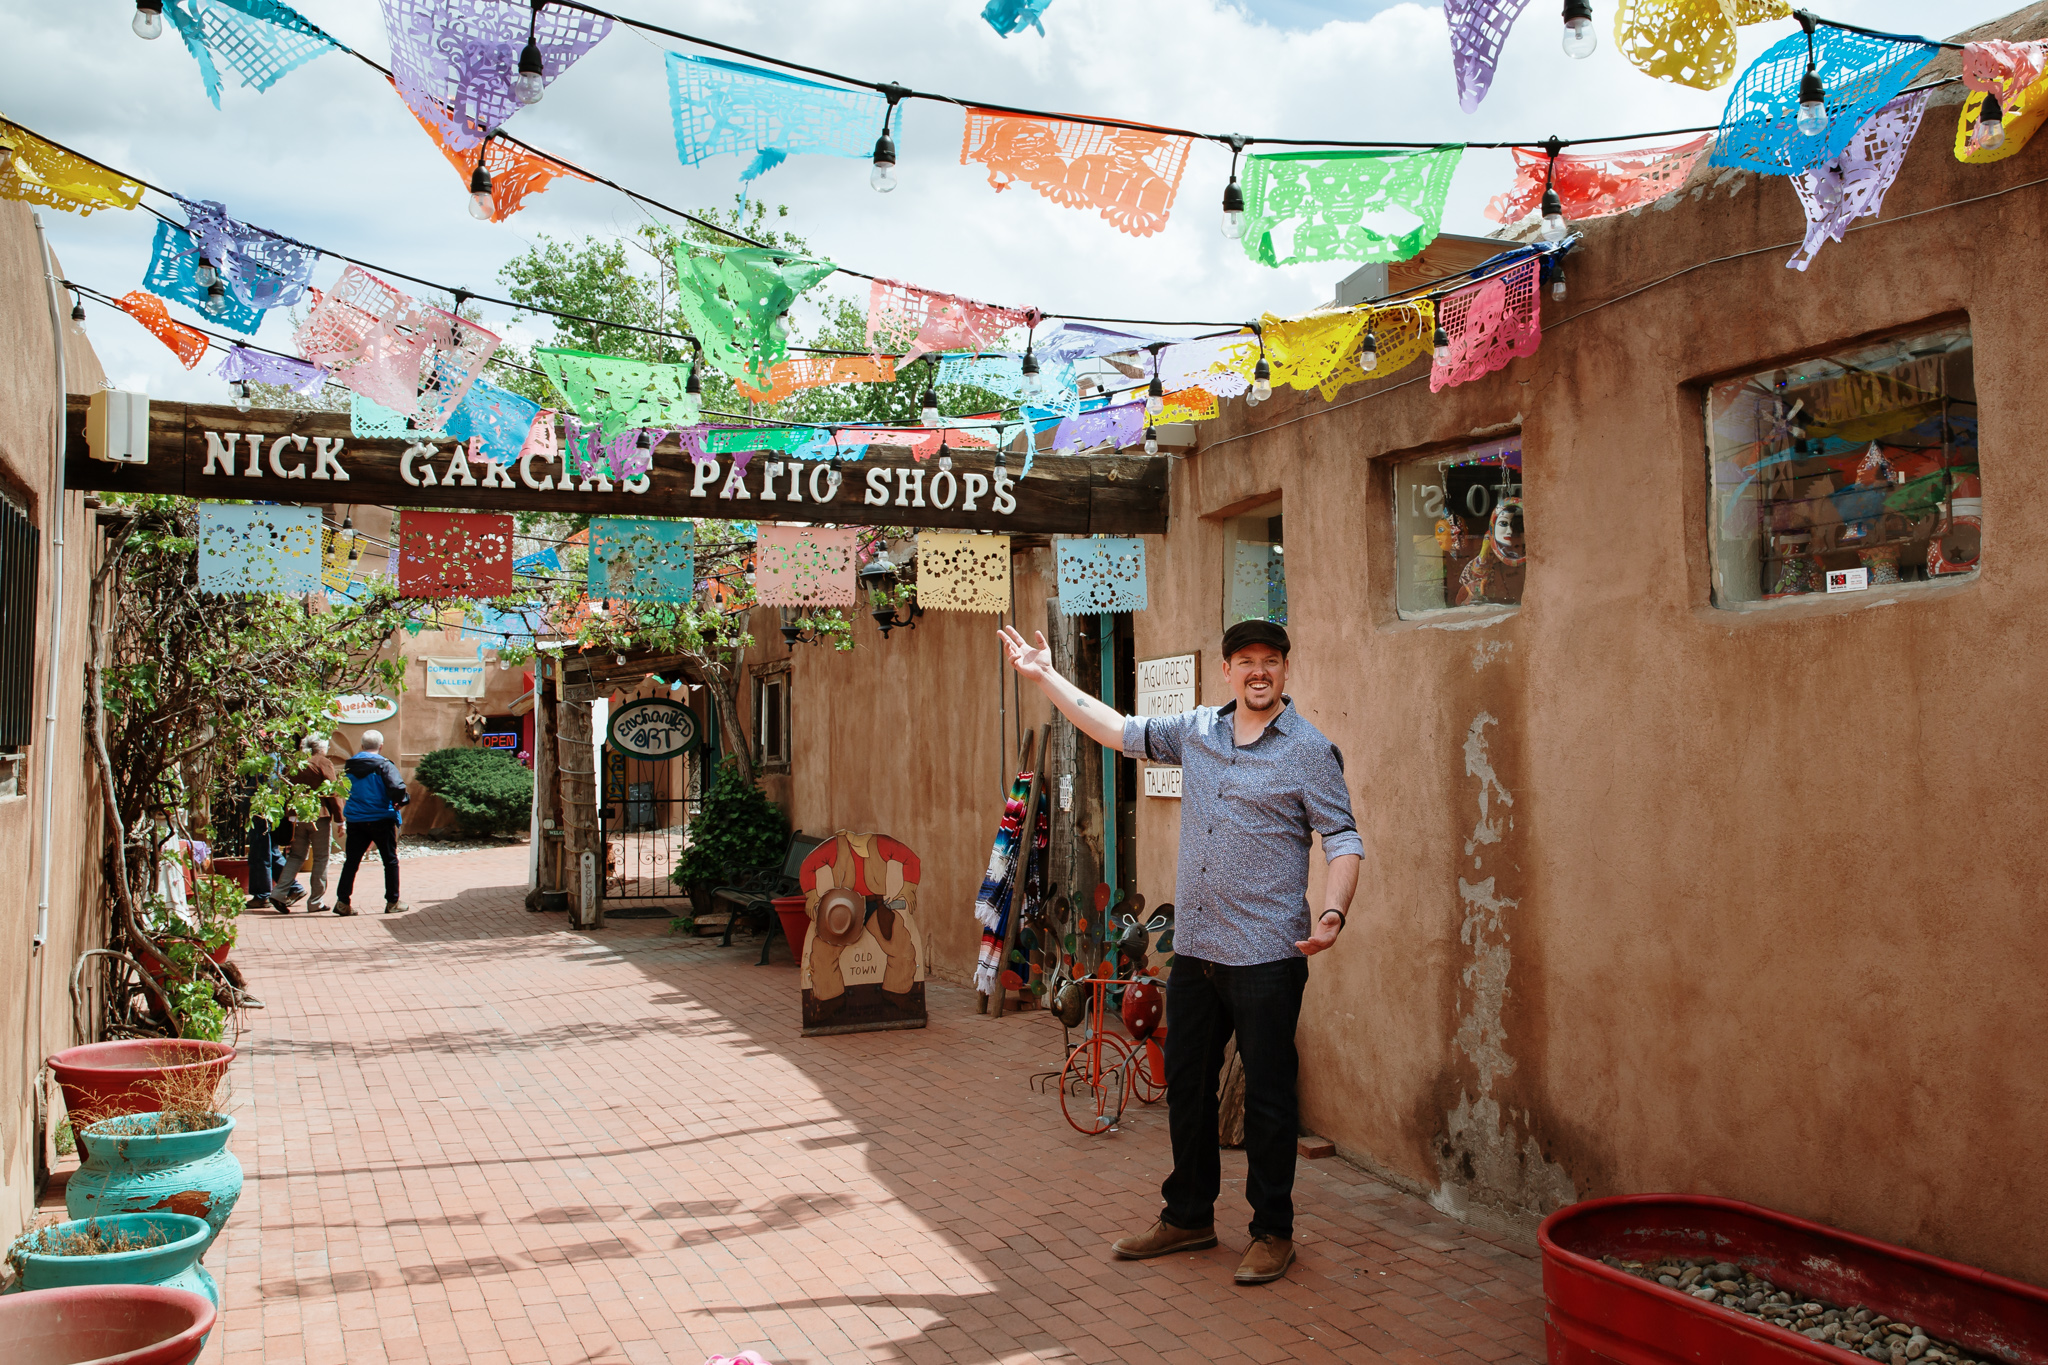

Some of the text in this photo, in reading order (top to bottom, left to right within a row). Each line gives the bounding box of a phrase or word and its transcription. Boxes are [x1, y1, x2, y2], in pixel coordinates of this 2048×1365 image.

[202, 431, 350, 481] NICK
[690, 457, 841, 503] PATIO
[864, 467, 1016, 515] SHOPS
[427, 665, 483, 674] COPPER TOPP
[436, 678, 473, 686] GALLERY
[1147, 692, 1185, 715] IMPORTS
[483, 735, 515, 748] OPEN
[629, 728, 676, 750] ART
[1146, 770, 1182, 793] TALAVER
[584, 863, 593, 909] WELCOME
[854, 952, 873, 962] OLD
[850, 965, 878, 976] TOWN
